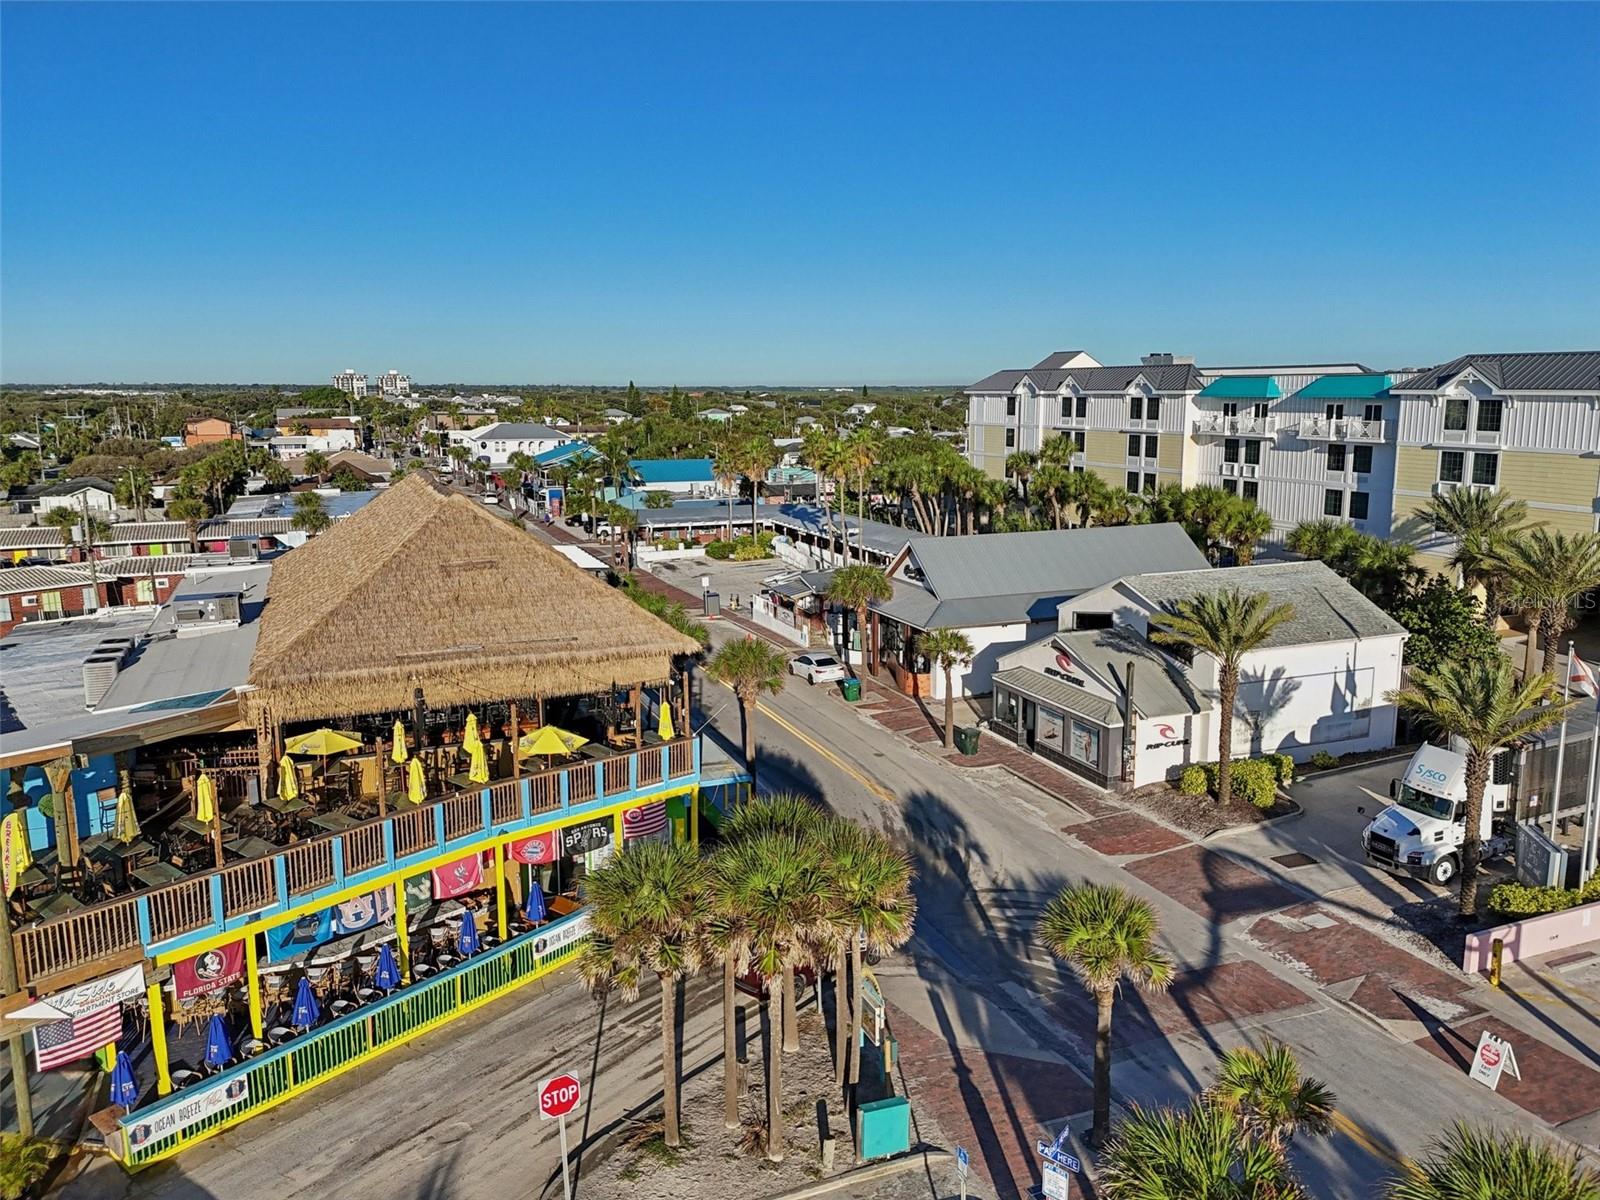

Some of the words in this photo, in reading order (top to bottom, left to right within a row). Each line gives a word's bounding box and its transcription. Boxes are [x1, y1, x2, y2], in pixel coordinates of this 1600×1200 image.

[117, 986, 139, 1001] STORE
[183, 982, 216, 997] FLORIDA
[218, 971, 241, 986] STATE
[543, 1085, 577, 1108] STOP
[154, 1112, 176, 1133] OCEAN
[178, 1100, 202, 1122] BREEZE
[1057, 1152, 1078, 1170] HERE
